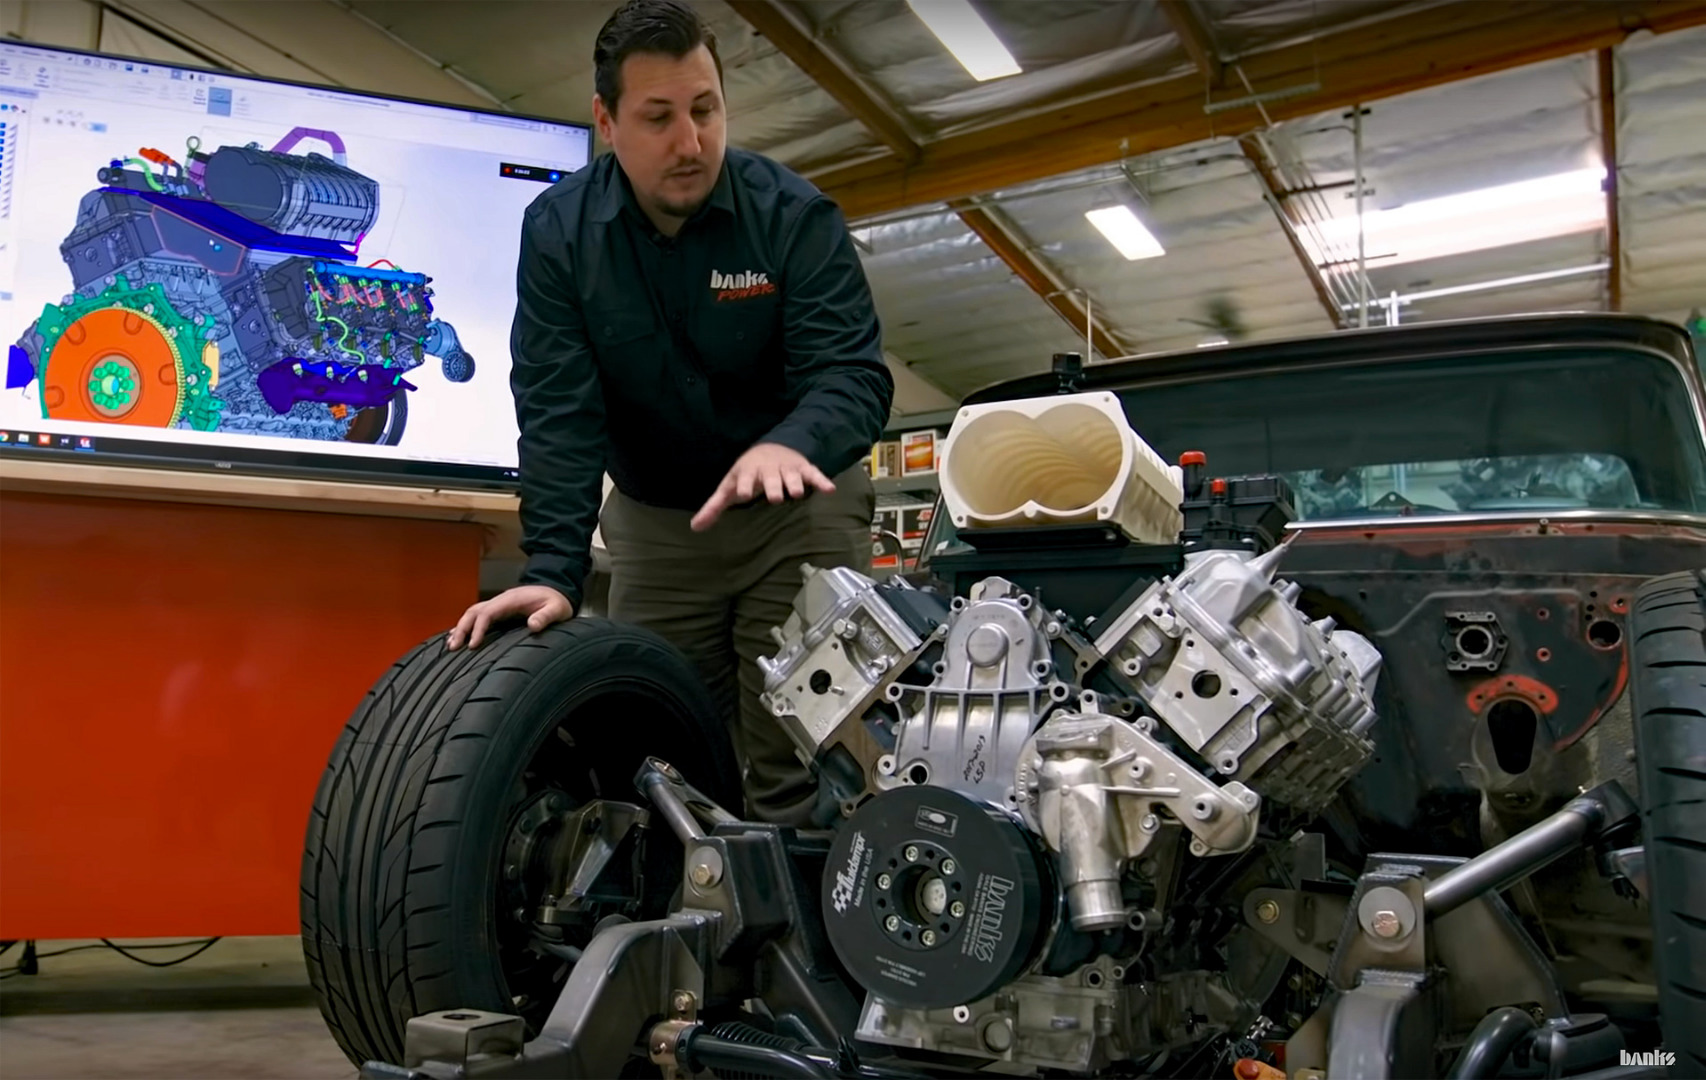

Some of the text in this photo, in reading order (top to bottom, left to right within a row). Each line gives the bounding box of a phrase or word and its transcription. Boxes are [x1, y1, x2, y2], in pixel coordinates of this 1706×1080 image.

[710, 269, 769, 289] banks
[864, 848, 874, 865] USA
[974, 875, 1015, 963] banks
